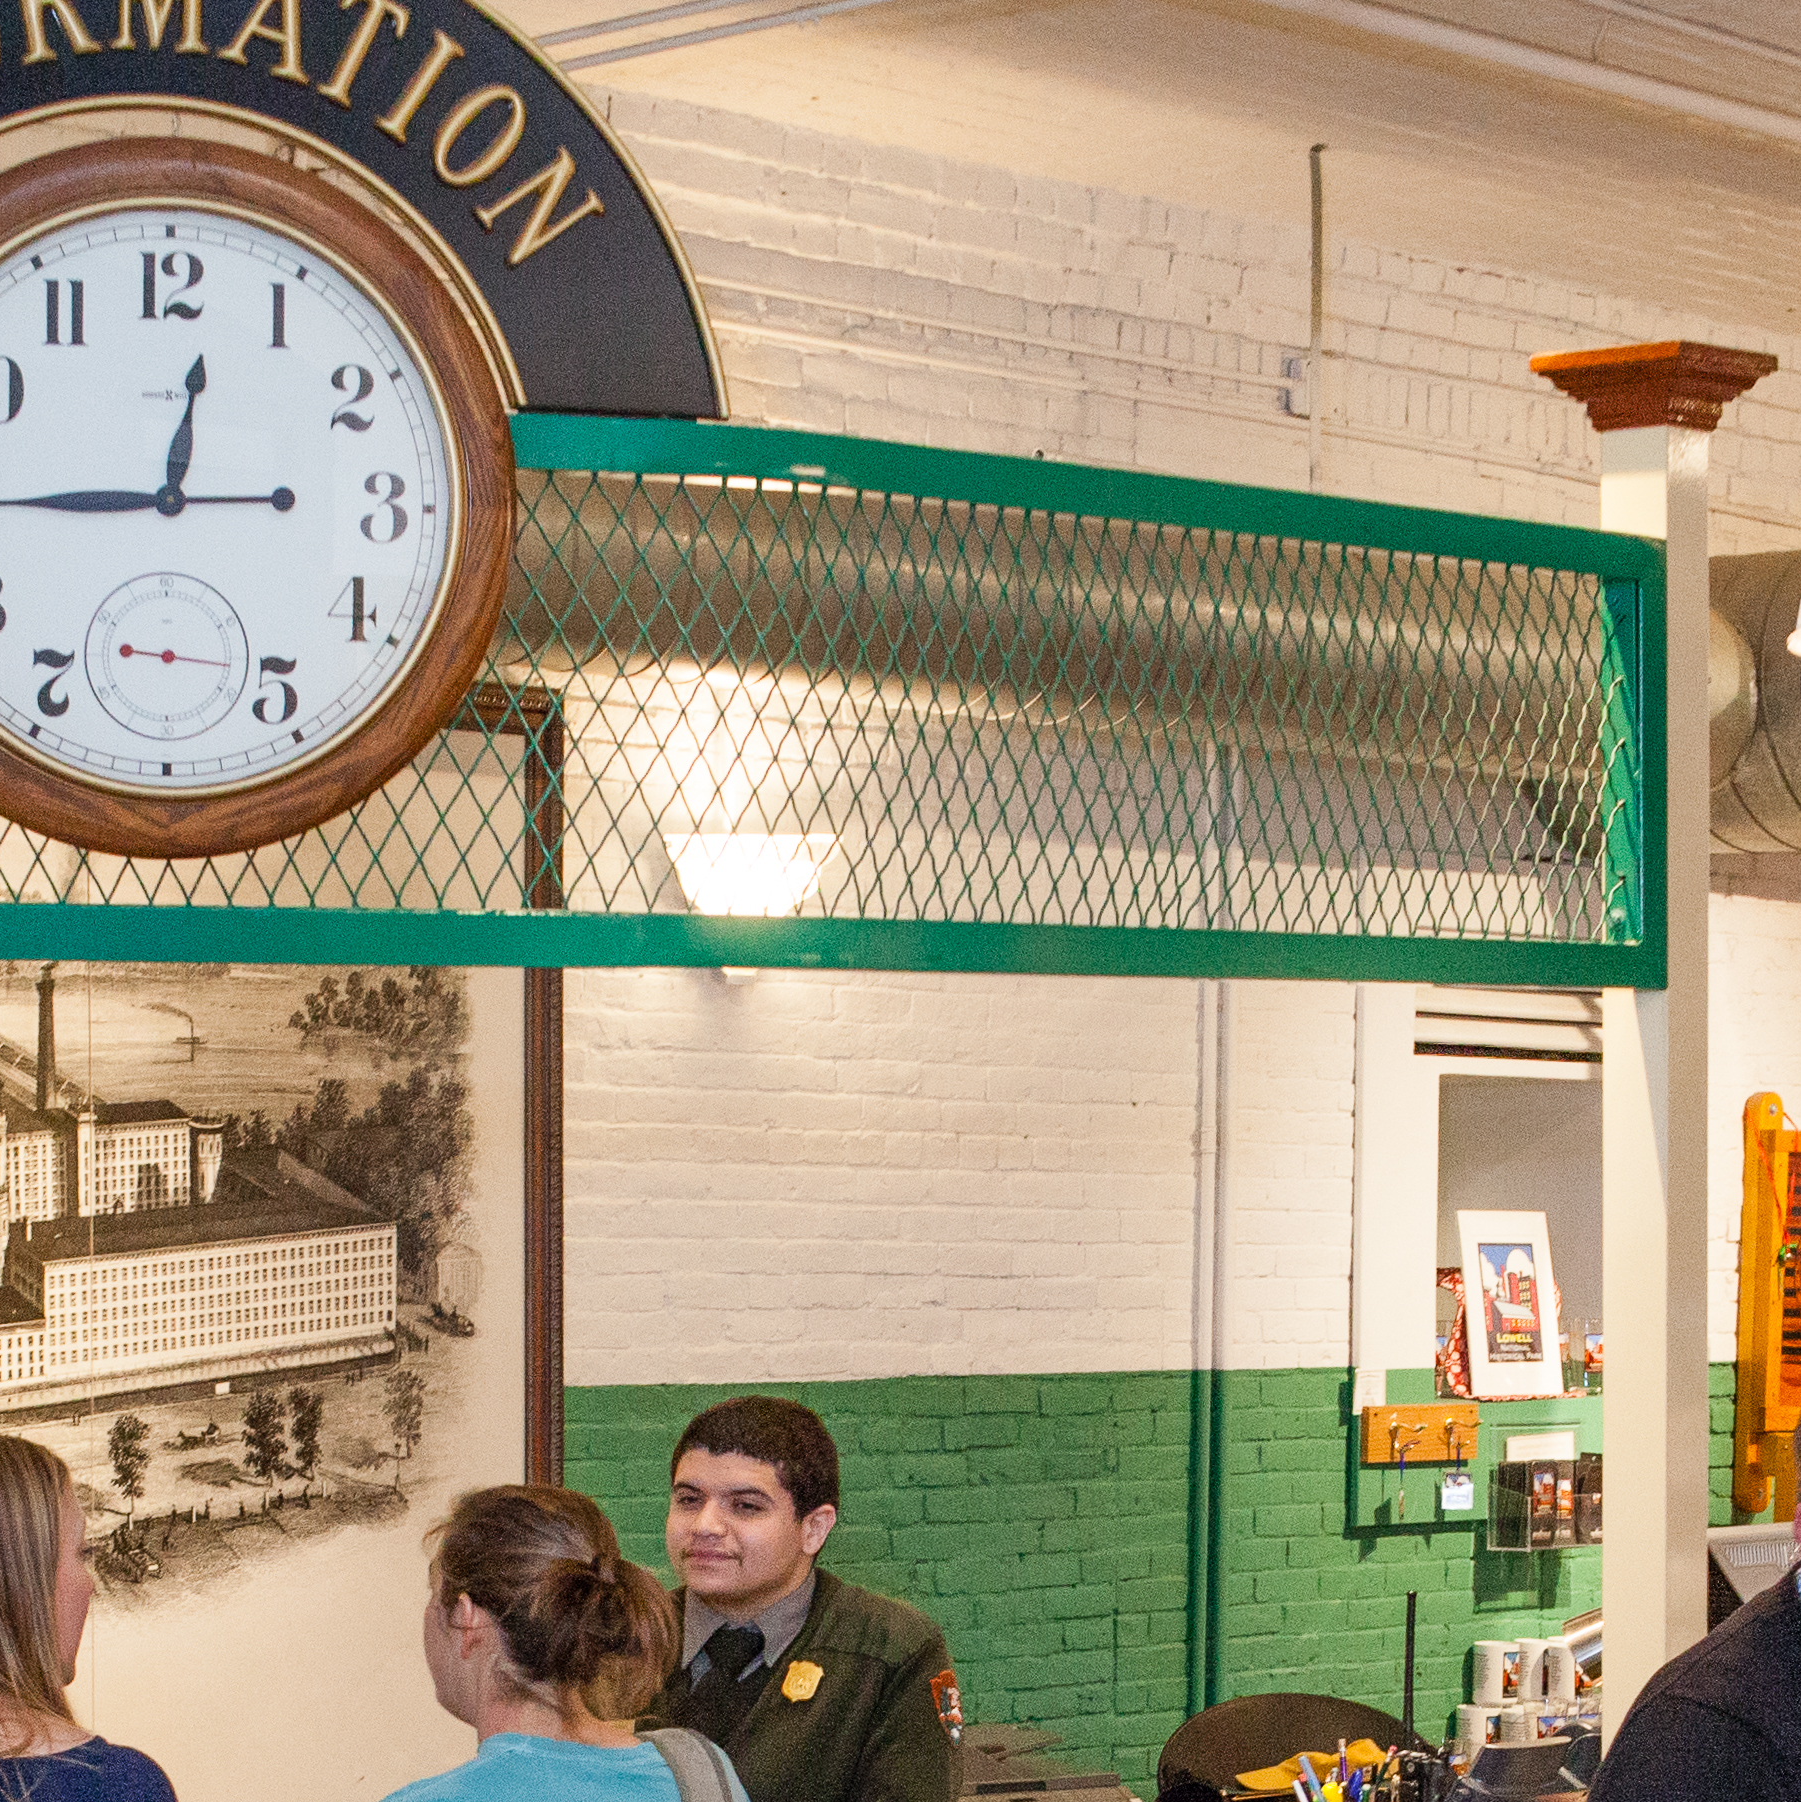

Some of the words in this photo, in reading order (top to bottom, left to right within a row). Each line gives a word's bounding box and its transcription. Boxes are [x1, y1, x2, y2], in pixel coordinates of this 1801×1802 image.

[43, 279, 88, 347] 11
[140, 251, 205, 320] 12
[268, 282, 288, 348] 1
[330, 364, 375, 432] 2
[360, 471, 408, 543] 3
[328, 576, 377, 642] 4
[32, 648, 75, 717] 7
[252, 656, 298, 725] 5
